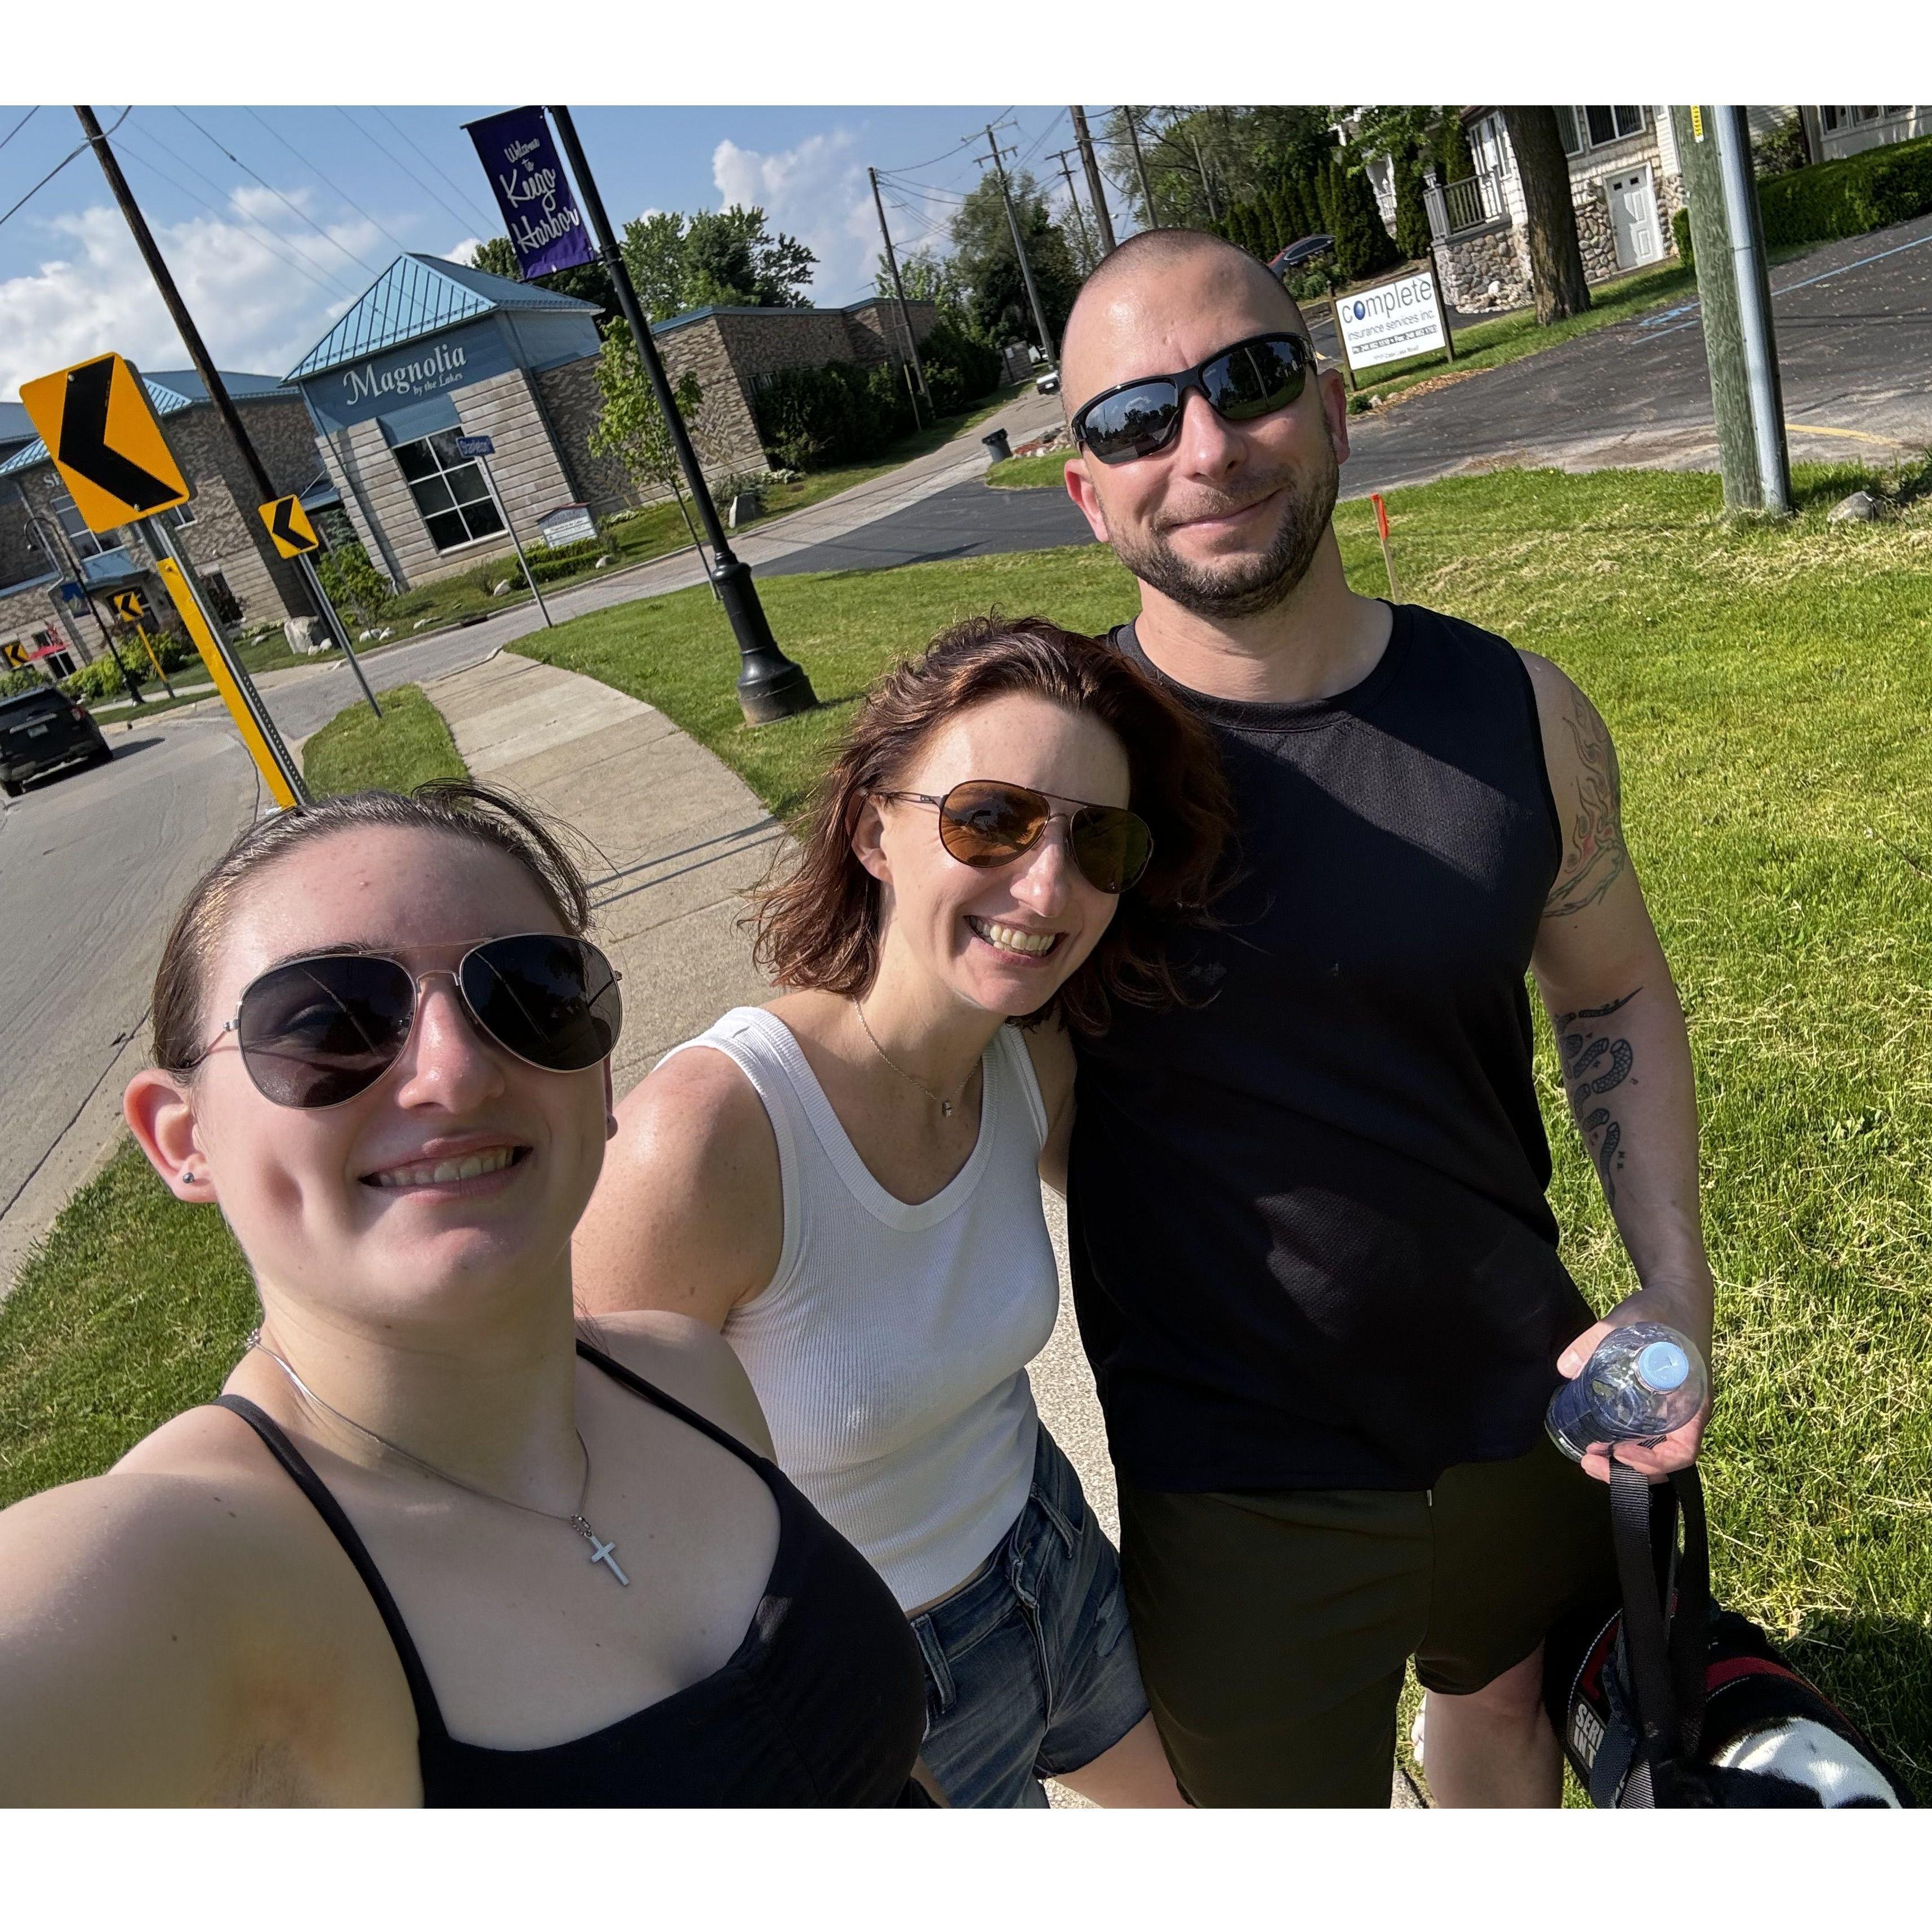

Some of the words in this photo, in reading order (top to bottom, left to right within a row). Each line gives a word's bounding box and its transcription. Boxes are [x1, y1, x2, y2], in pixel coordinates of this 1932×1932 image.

[504, 138, 540, 163] Welcome
[522, 158, 535, 172] to
[499, 168, 556, 211] Keego
[511, 206, 580, 254] Harbor
[1342, 277, 1432, 324] complete
[343, 344, 467, 405] Magnolia
[412, 385, 424, 397] by
[424, 380, 437, 392] the
[439, 372, 463, 387] Lakes
